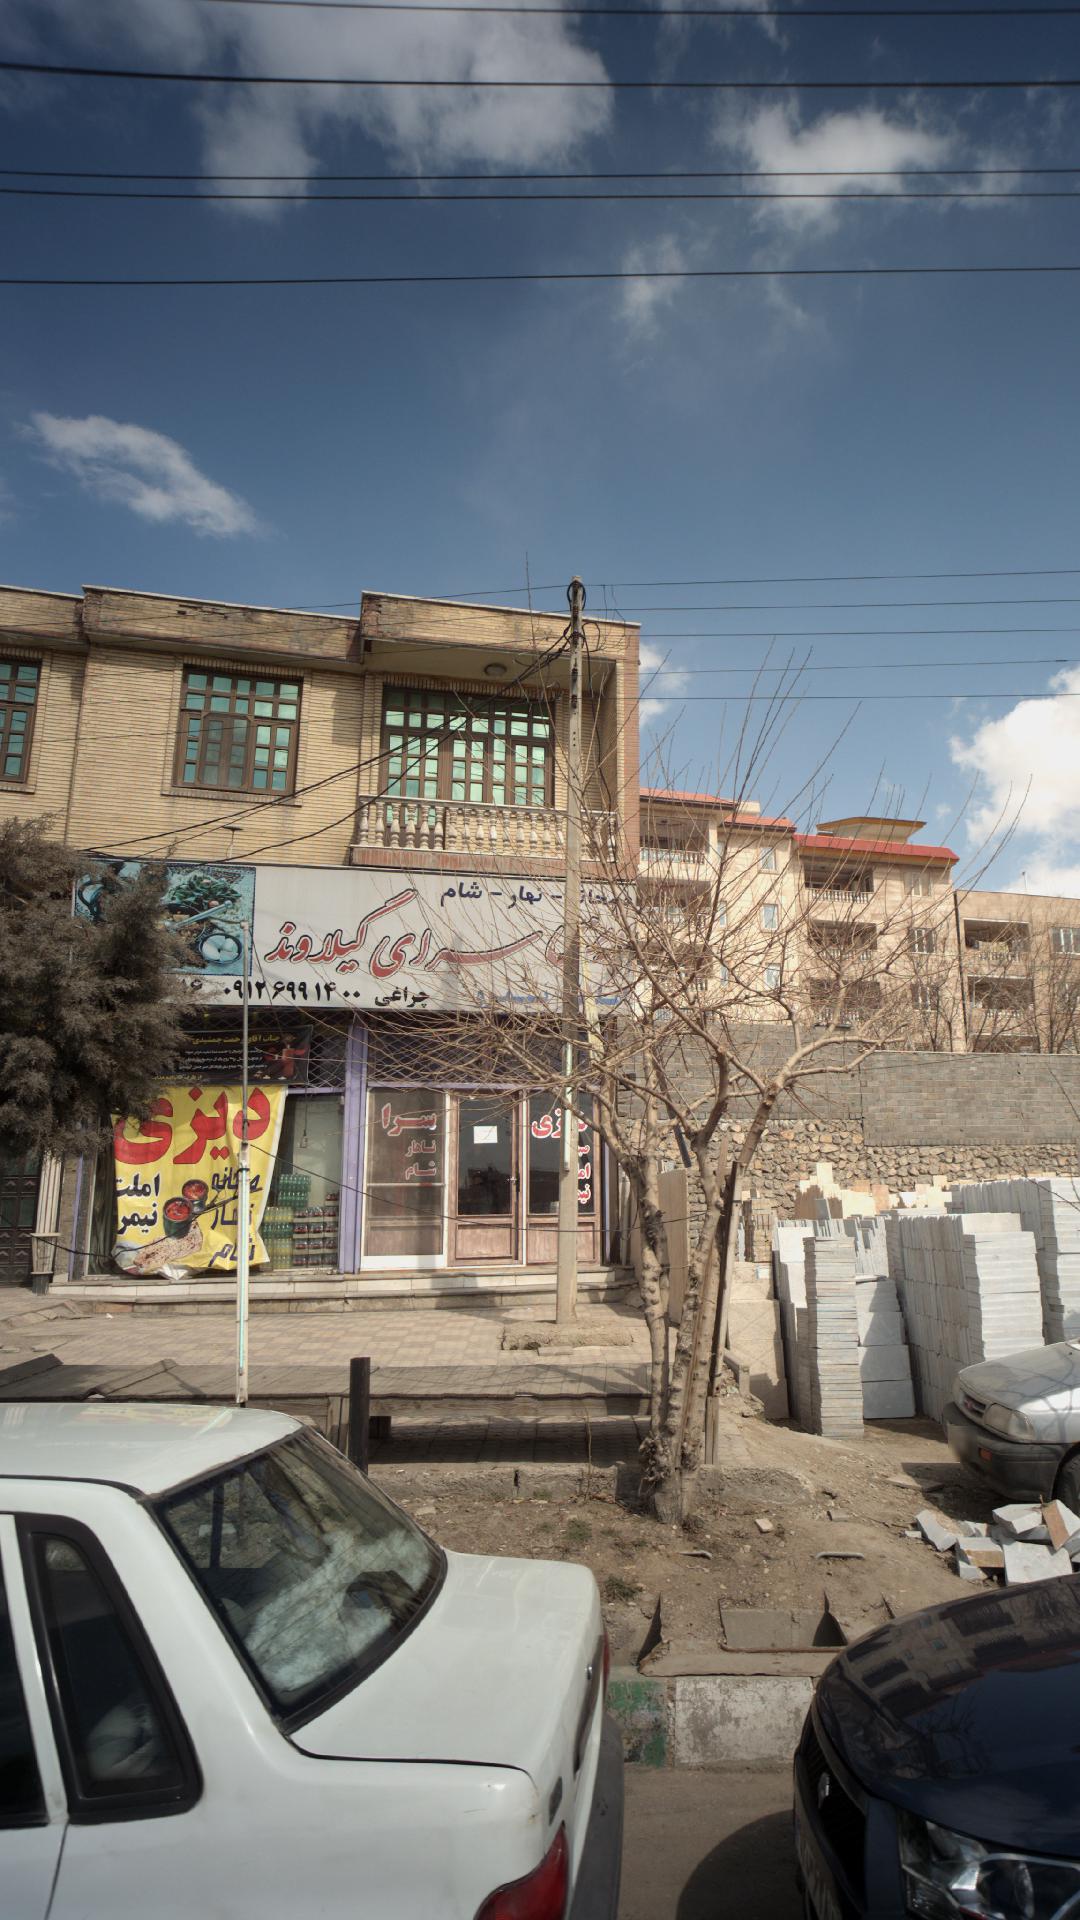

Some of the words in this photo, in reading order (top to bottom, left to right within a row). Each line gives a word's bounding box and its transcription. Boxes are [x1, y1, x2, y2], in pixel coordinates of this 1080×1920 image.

[440, 881, 483, 907] شام
[507, 886, 543, 909] نهار
[264, 888, 418, 975] گیلاوند
[374, 986, 430, 1008] چراغی
[114, 1086, 271, 1165] دیزی
[381, 1103, 437, 1137] سرا
